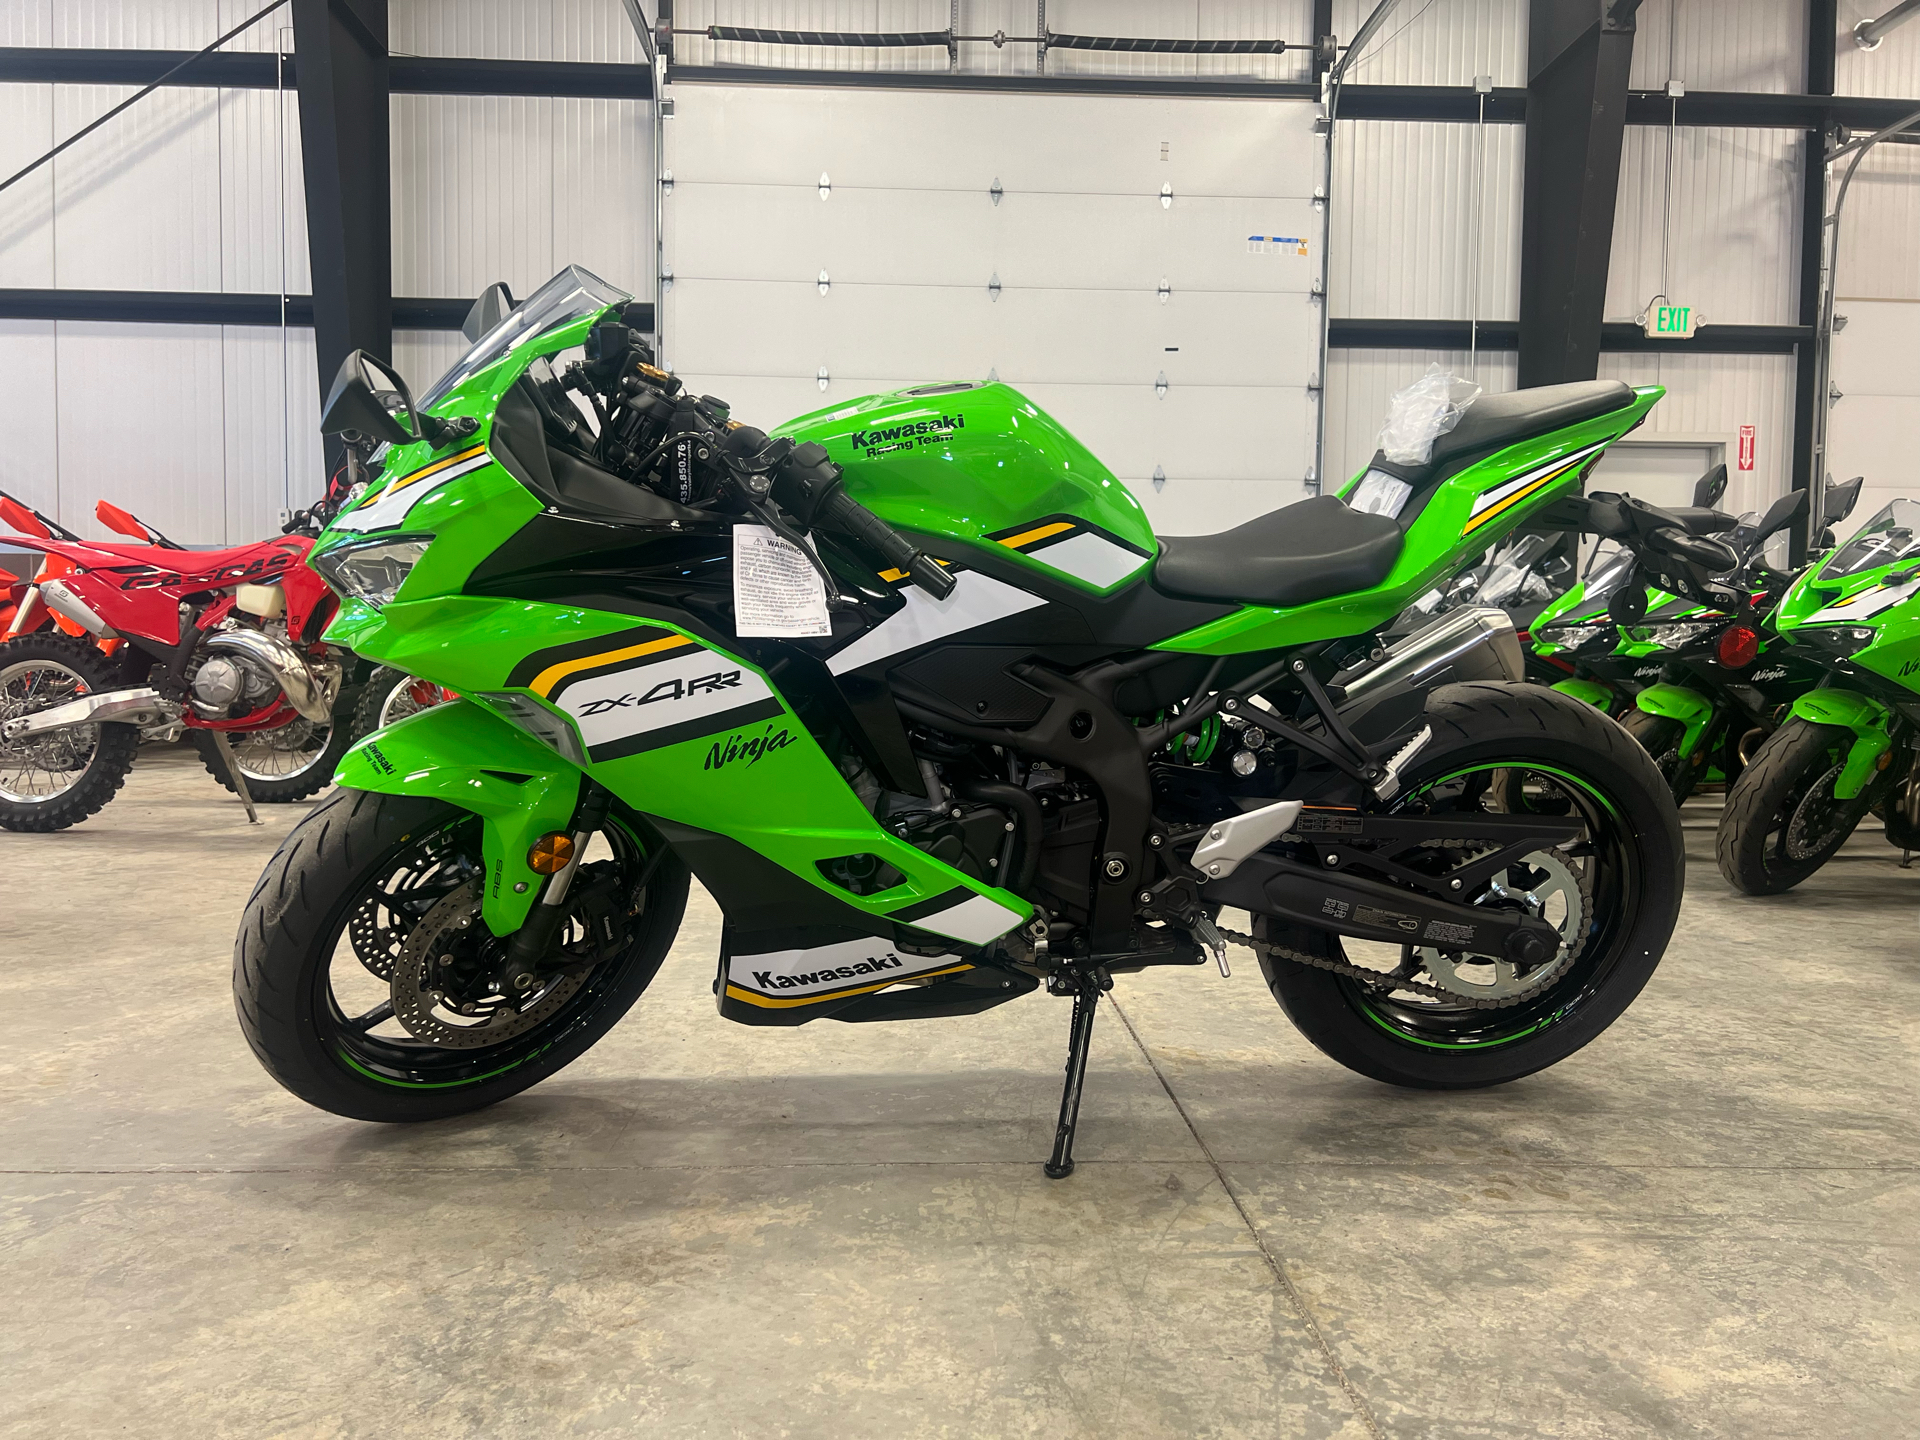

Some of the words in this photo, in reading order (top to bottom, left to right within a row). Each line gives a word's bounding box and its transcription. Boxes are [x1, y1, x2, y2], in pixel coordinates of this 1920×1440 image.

[1657, 307, 1690, 332] EXIT
[851, 414, 965, 450] Kawasaki
[866, 440, 913, 458] Racing
[915, 433, 954, 446] Team
[677, 441, 688, 504] 435.850.76
[767, 539, 802, 556] WARNING
[1751, 667, 1787, 682] Ninja
[578, 670, 743, 717] ZX-4RR
[703, 724, 798, 770] Ninja
[492, 858, 503, 899] ABS
[752, 953, 903, 989] Kawasaki
